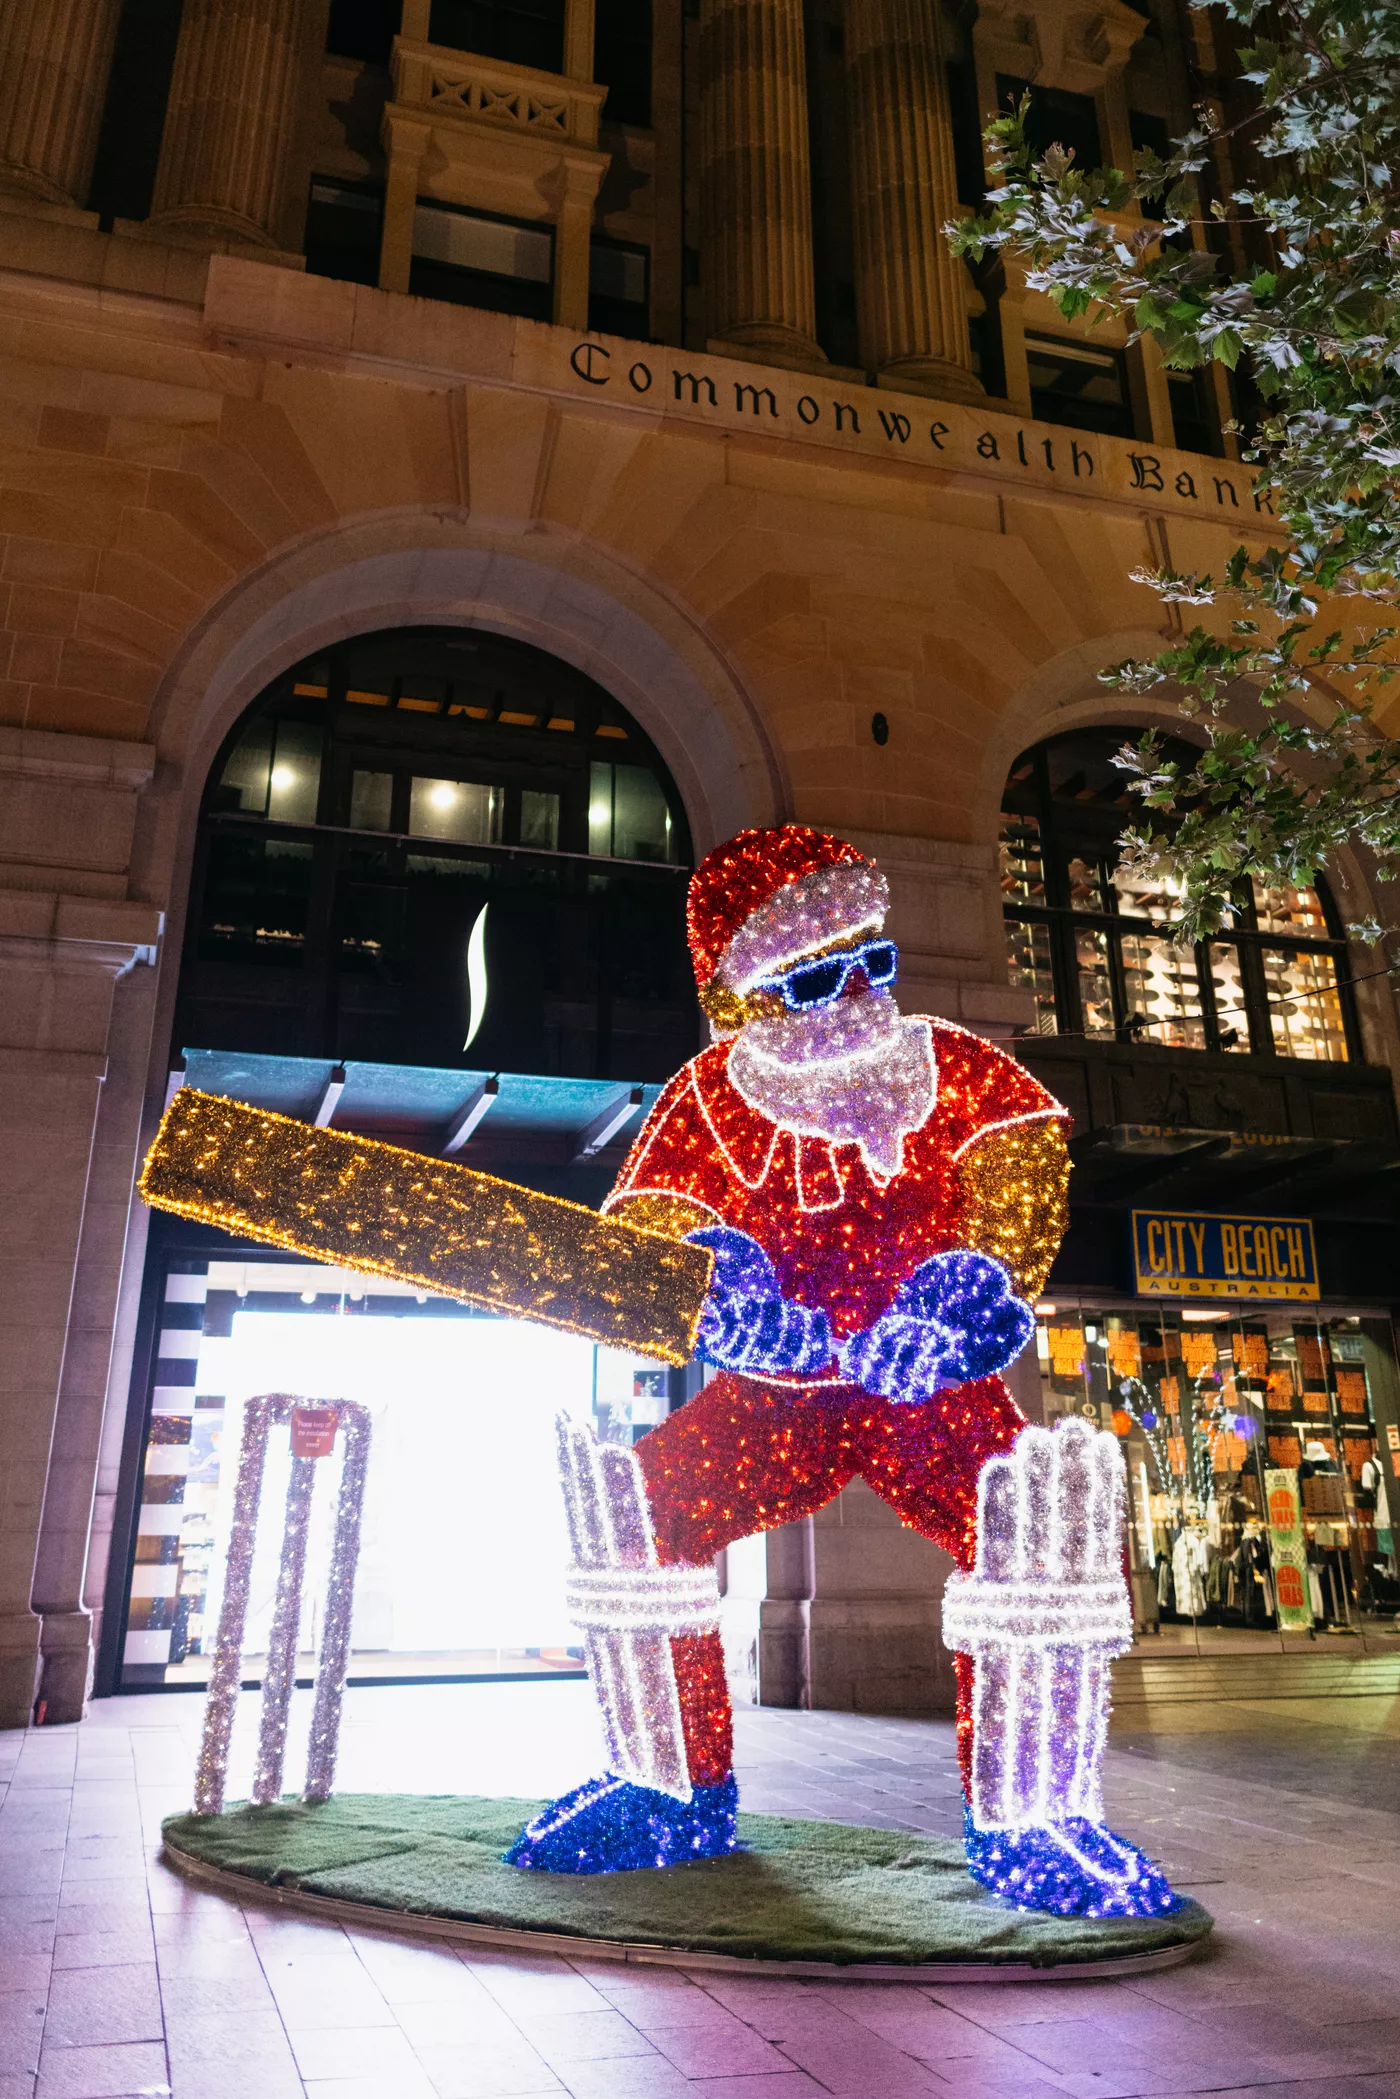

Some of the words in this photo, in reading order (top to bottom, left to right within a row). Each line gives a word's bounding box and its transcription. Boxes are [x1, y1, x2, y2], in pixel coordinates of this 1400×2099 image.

[570, 342, 1095, 477] Commonwealth
[1146, 1219, 1205, 1274] CITY
[1220, 1223, 1307, 1279] BEACH
[1149, 1280, 1310, 1297] AUSTRALIA
[1053, 1358, 1083, 1375] SALE
[298, 1420, 312, 1428] Please
[313, 1421, 324, 1429] keep
